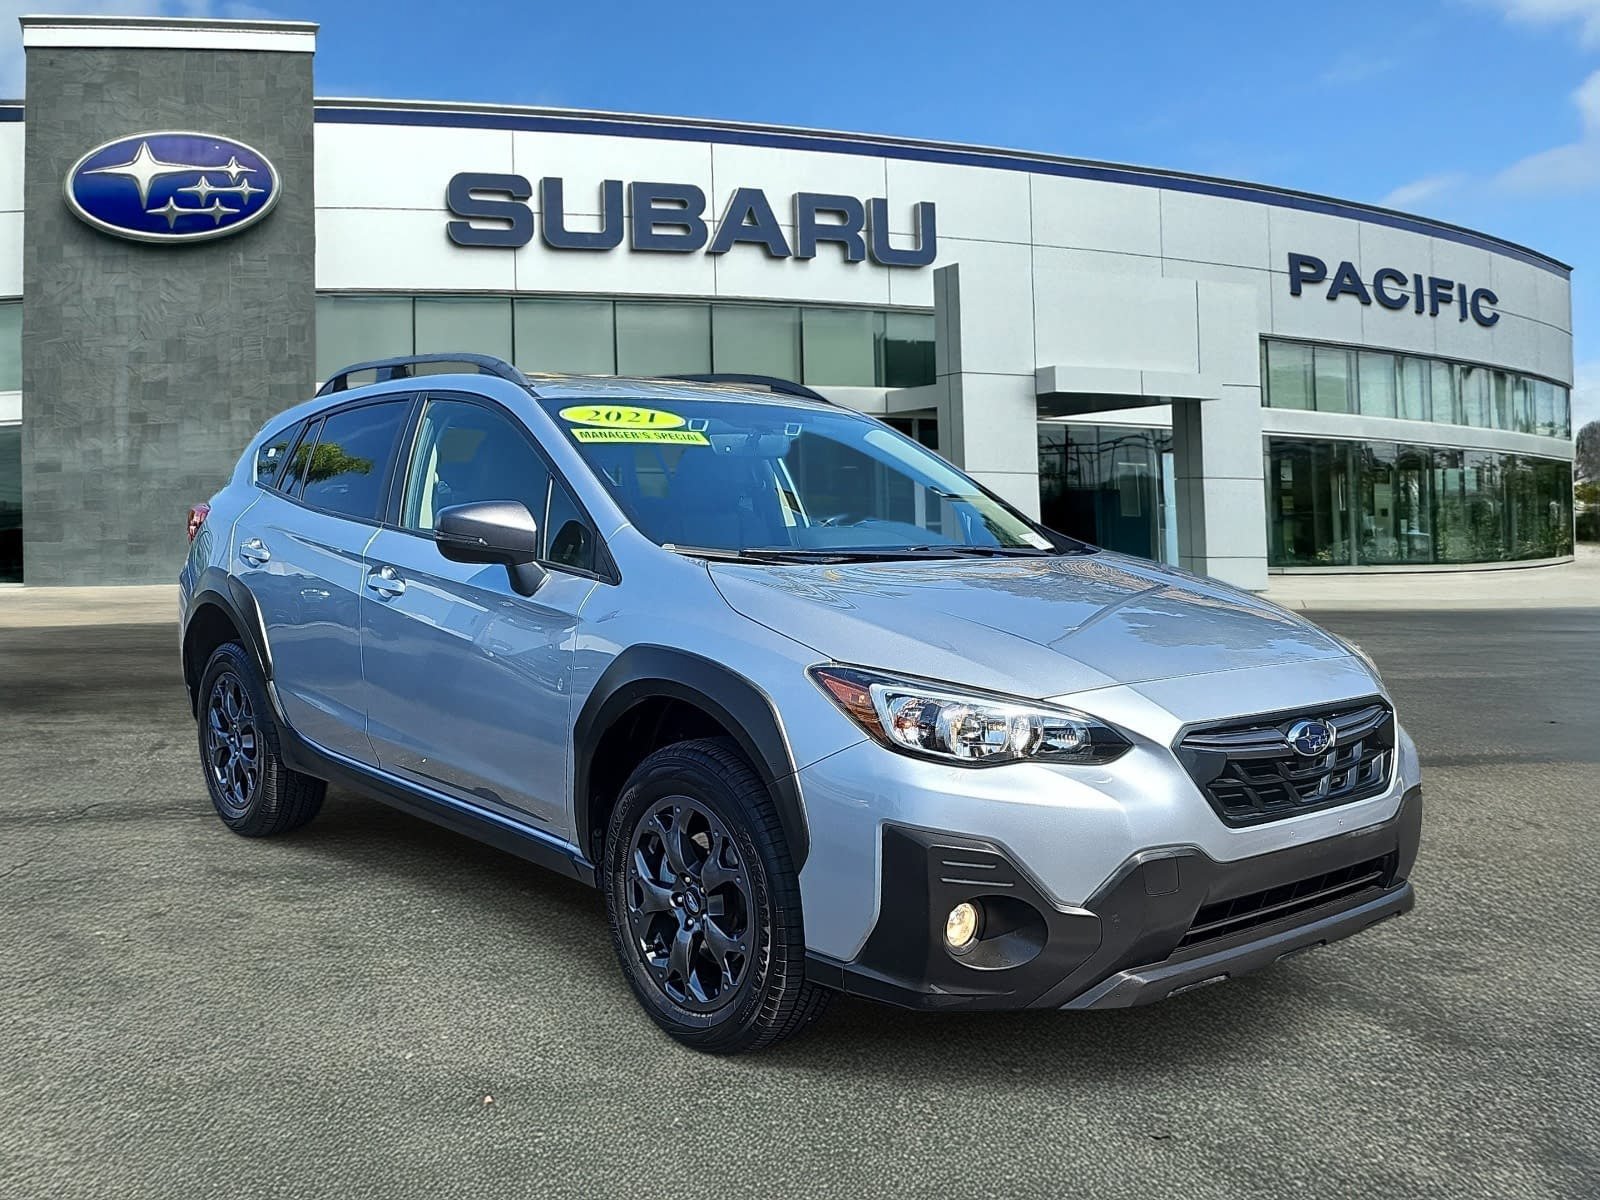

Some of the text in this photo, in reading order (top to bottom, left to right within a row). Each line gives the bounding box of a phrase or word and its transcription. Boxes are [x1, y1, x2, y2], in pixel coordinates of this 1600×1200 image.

[447, 172, 937, 267] SUBARU
[1288, 252, 1500, 327] PACIFIC
[580, 431, 702, 442] MANAGER'S SPECIAL
[586, 410, 656, 423] 2021
